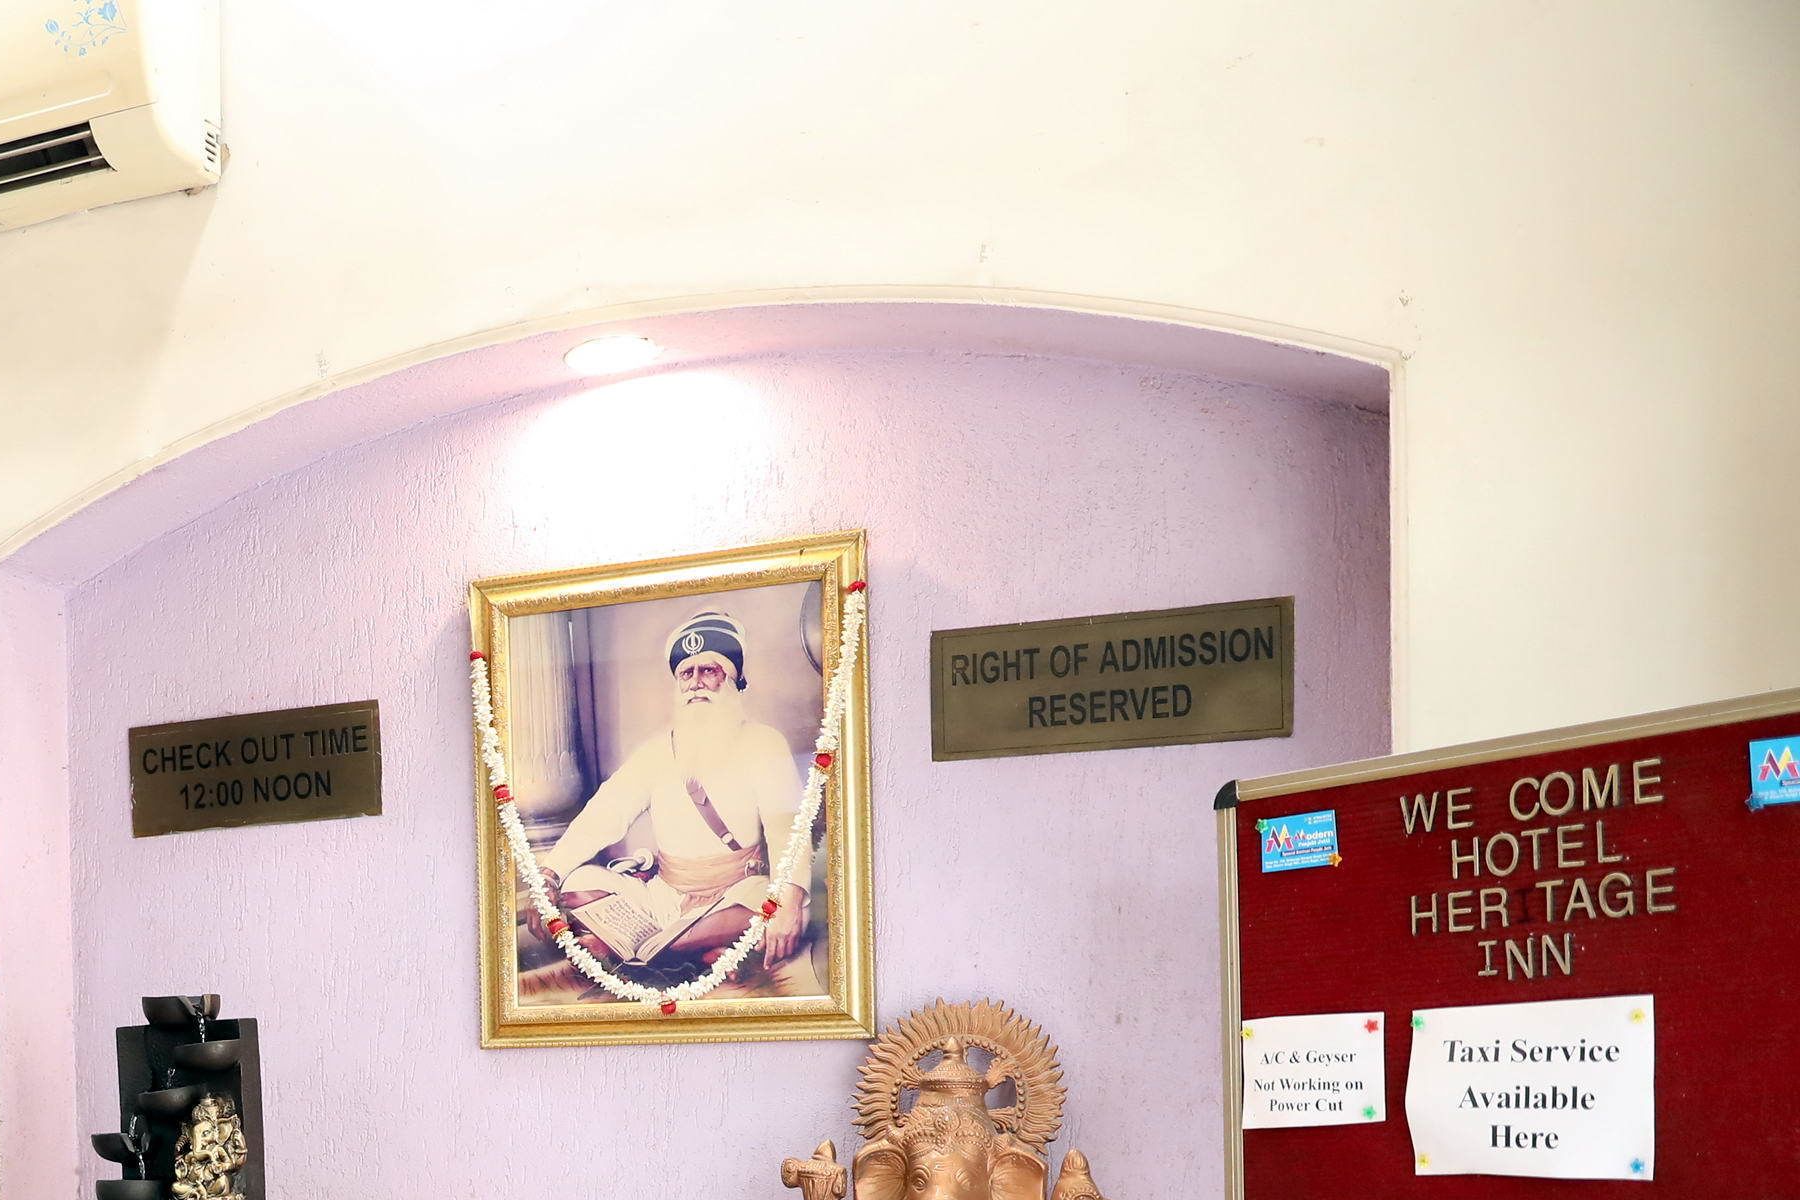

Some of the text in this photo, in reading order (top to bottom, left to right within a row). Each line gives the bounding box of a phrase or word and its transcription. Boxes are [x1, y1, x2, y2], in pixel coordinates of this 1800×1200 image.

[951, 625, 1274, 687] RIGHT OF ADMISSION
[1028, 684, 1192, 728] RESERVED
[142, 724, 369, 775] CHECK OUT TIME
[179, 770, 332, 810] 12:00 NOON
[1399, 757, 1665, 835] WE COME
[1451, 819, 1624, 880] HOTEL
[1477, 932, 1573, 981] INN
[1260, 1049, 1357, 1067] A/C & Geyser
[1443, 1037, 1621, 1064] Taxi Service
[1254, 1077, 1364, 1093] Not Working on
[1269, 1098, 1343, 1112] Power Cut
[1458, 1084, 1596, 1111] Available
[1489, 1124, 1560, 1150] Here
